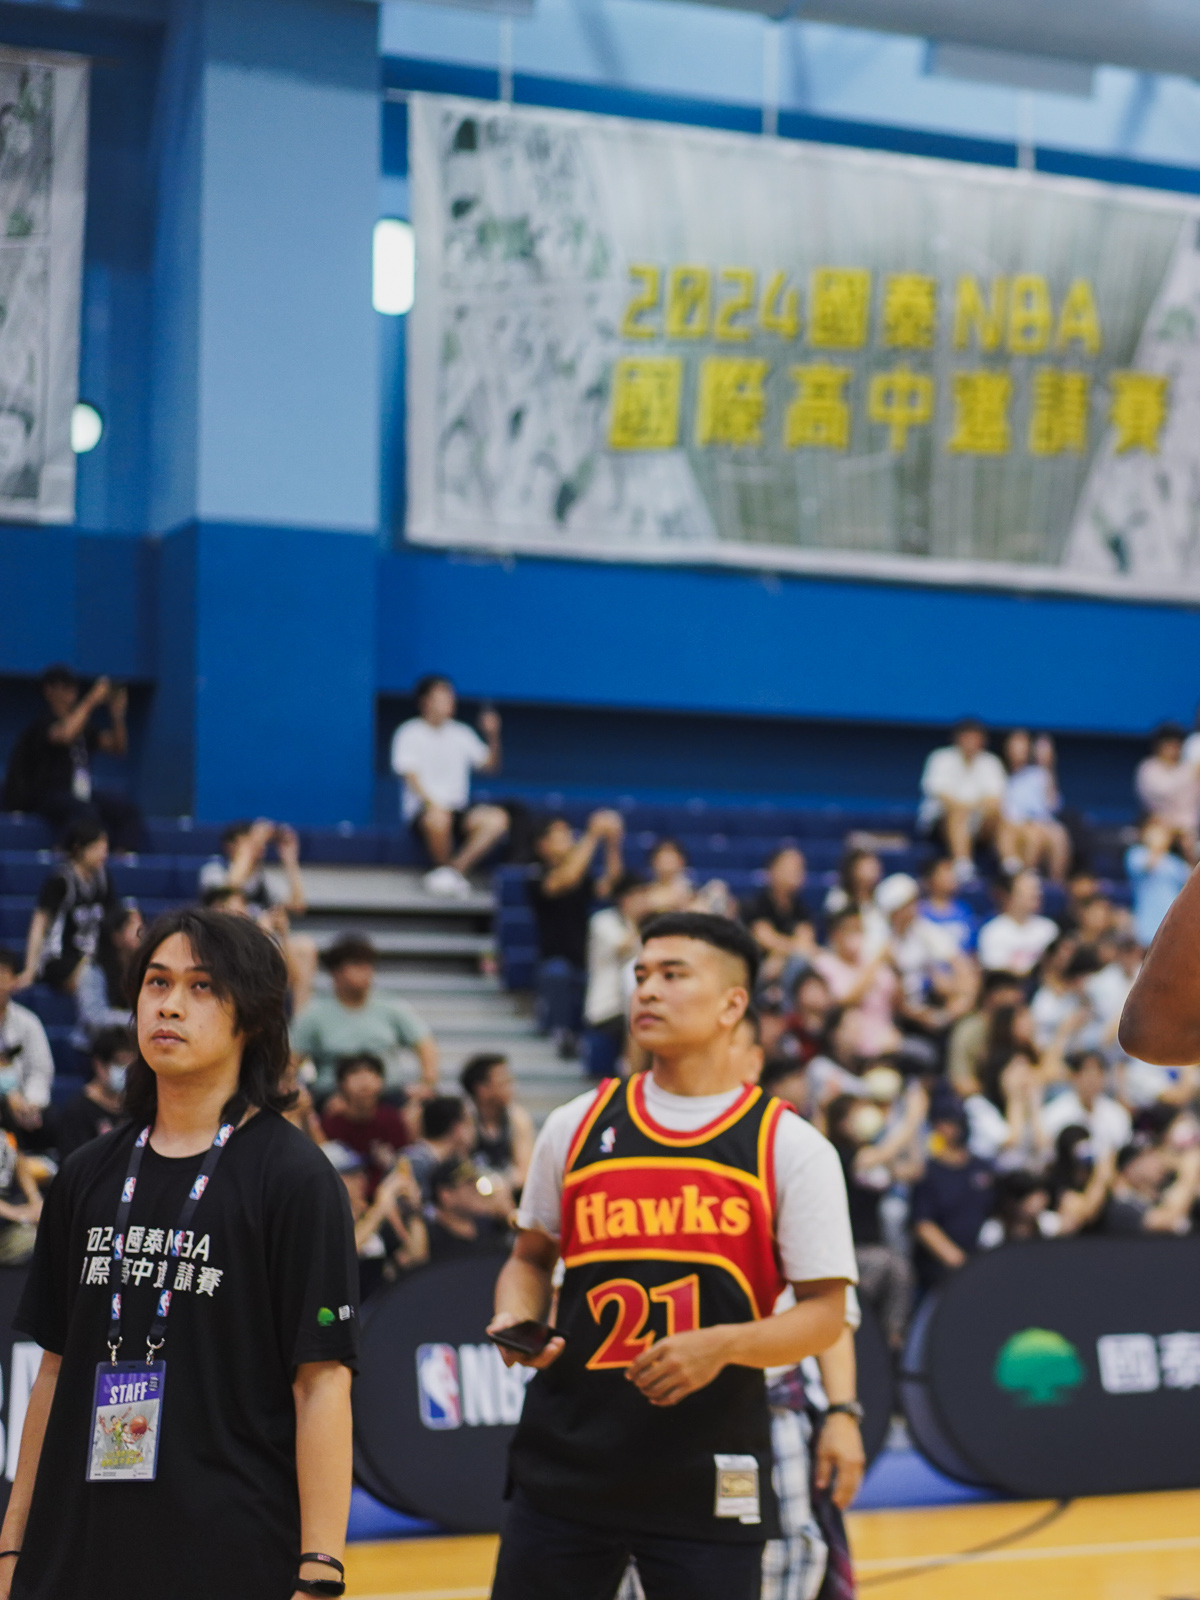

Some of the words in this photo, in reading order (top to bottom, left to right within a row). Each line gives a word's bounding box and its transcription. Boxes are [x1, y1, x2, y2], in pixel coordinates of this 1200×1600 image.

[575, 1184, 751, 1245] Hawks
[585, 1273, 700, 1371] 21
[109, 1381, 149, 1405] STAFF
[458, 1343, 538, 1426] NB
